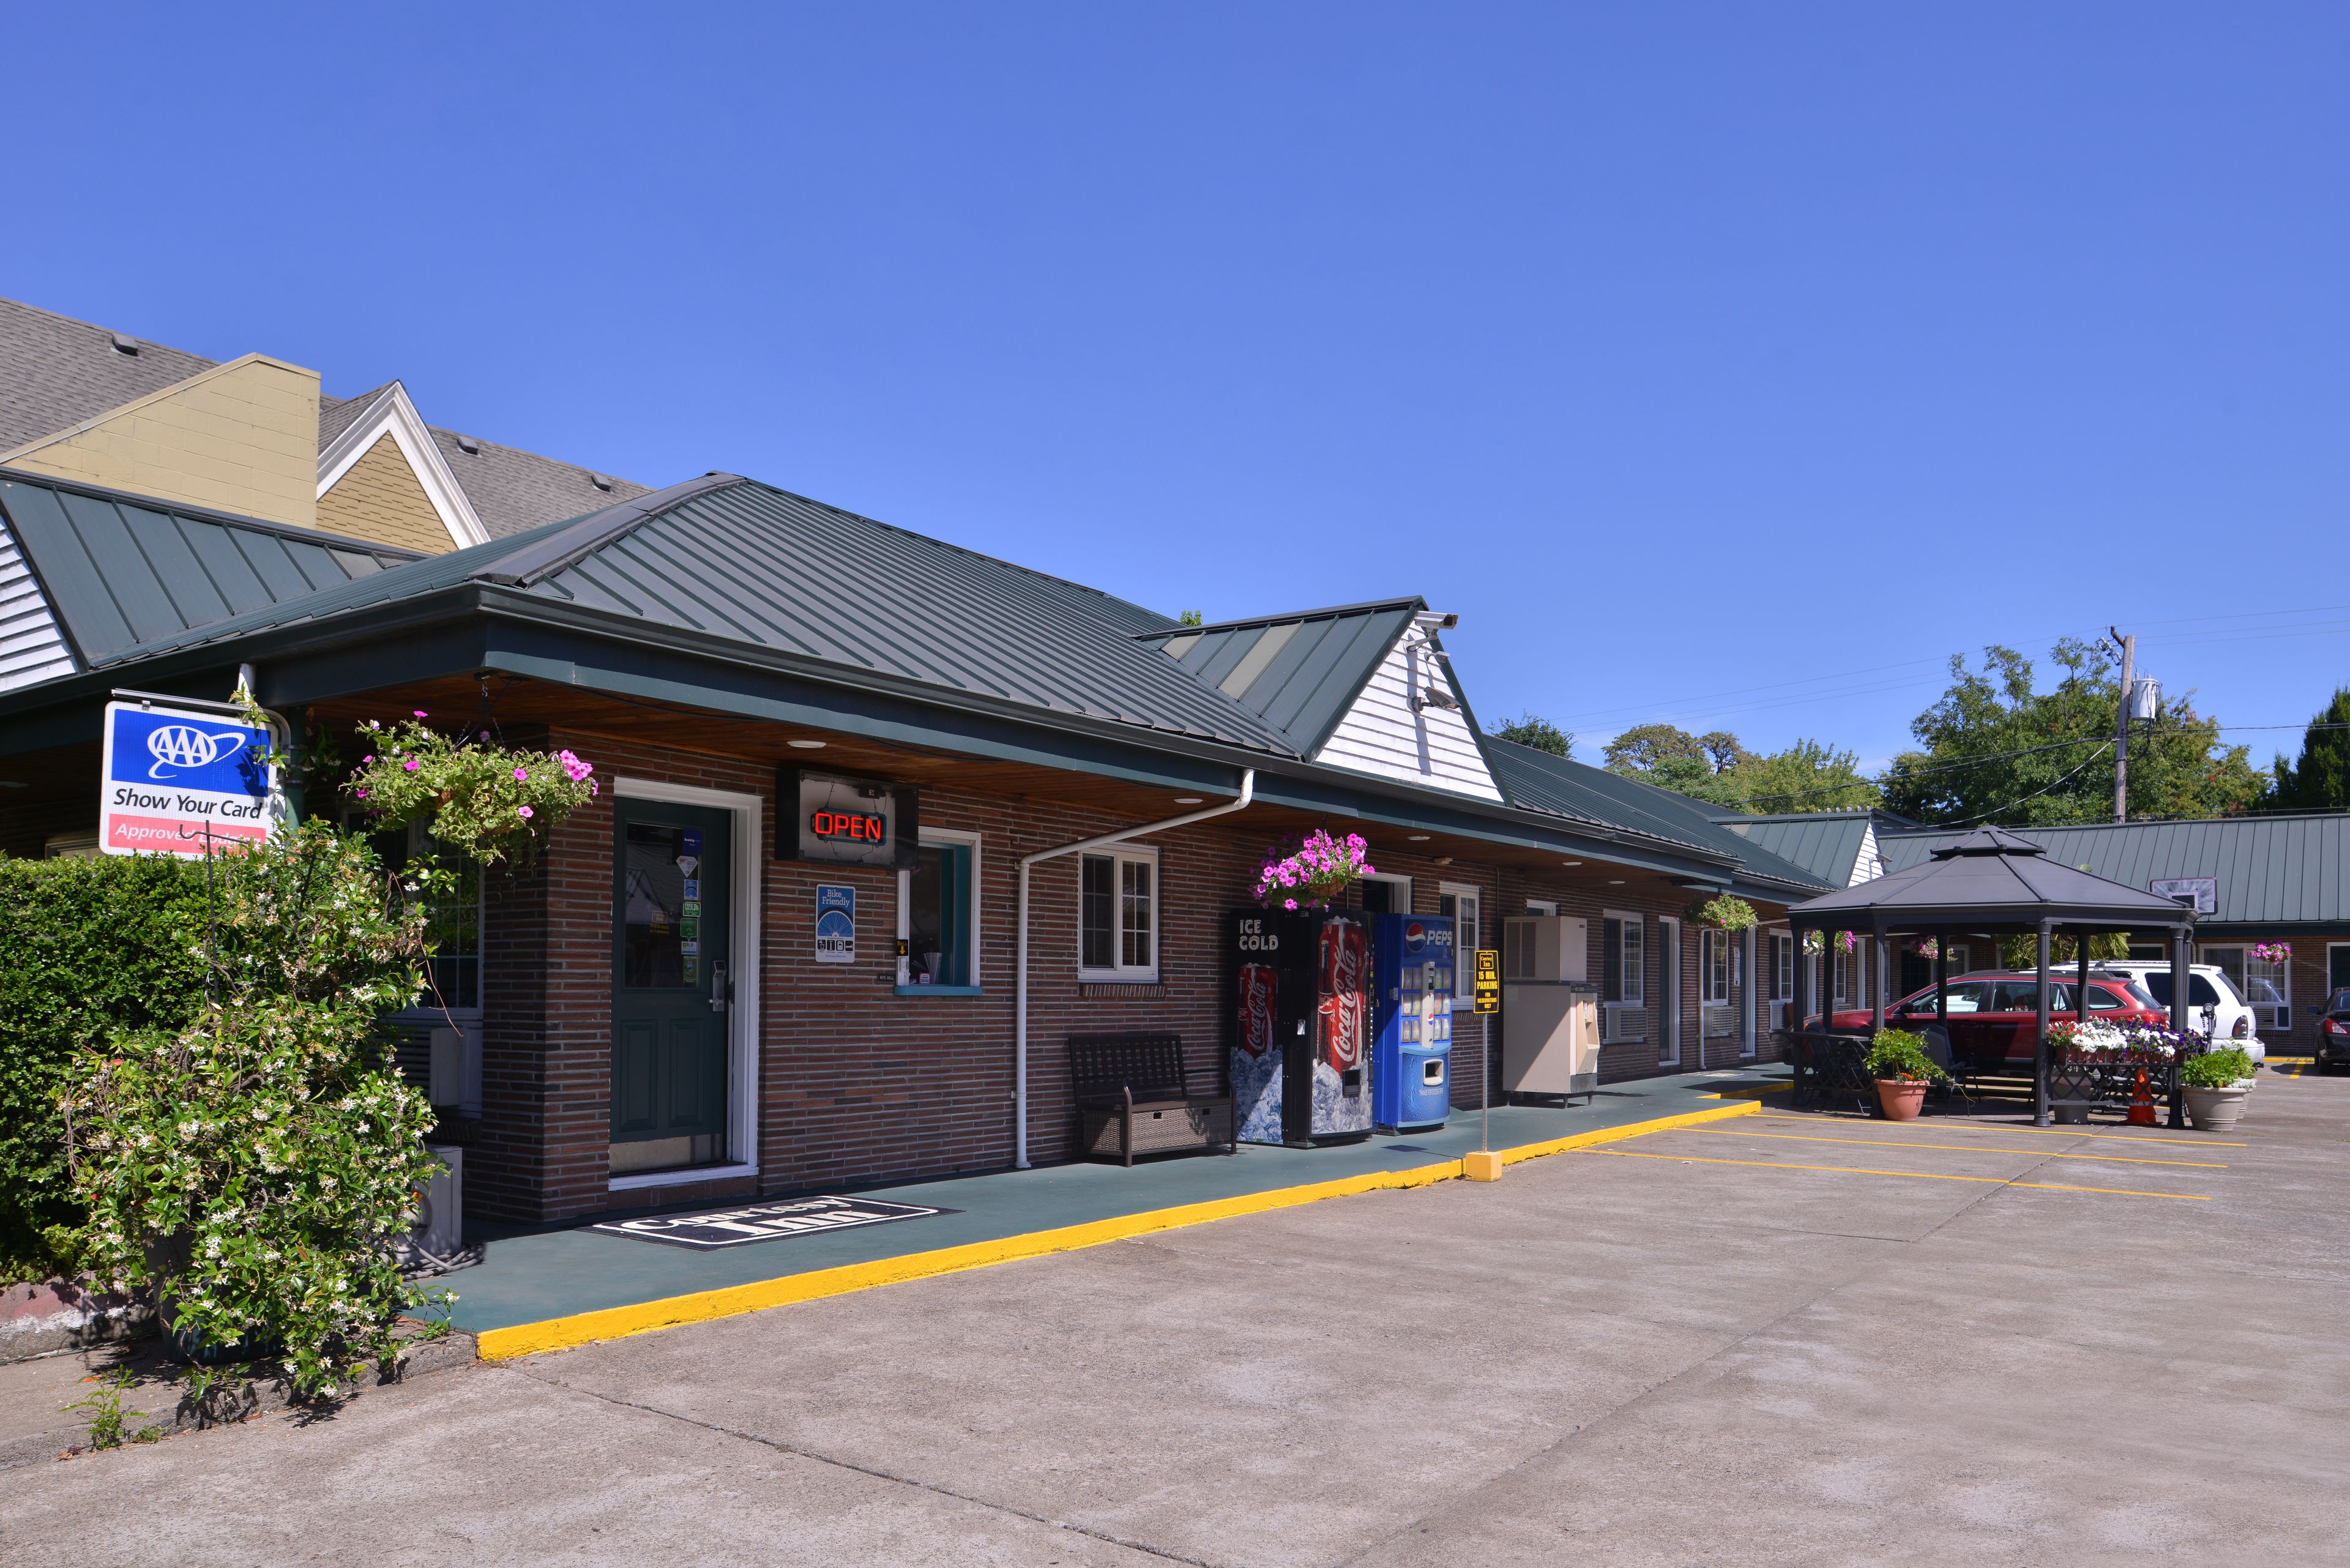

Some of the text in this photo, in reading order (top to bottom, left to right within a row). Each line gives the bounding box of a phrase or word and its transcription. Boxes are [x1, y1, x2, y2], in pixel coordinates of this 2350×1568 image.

[155, 726, 210, 766] AAA
[114, 788, 263, 819] Show Your Card
[115, 823, 196, 842] Approved
[815, 813, 881, 840] OPEN
[822, 896, 850, 908] Friendly
[827, 889, 842, 898] Bike
[1239, 919, 1261, 934] ICE
[1239, 935, 1278, 951] COLD
[1427, 930, 1453, 946] PEPSI
[1479, 971, 1496, 980] 15 MIN.
[1477, 981, 1498, 990] PARKING
[1333, 944, 1357, 1062] Coca-Cola
[1247, 979, 1266, 1051] Coca-Cola
[621, 1199, 852, 1230] Courtesy
[692, 1210, 891, 1236] Inn
